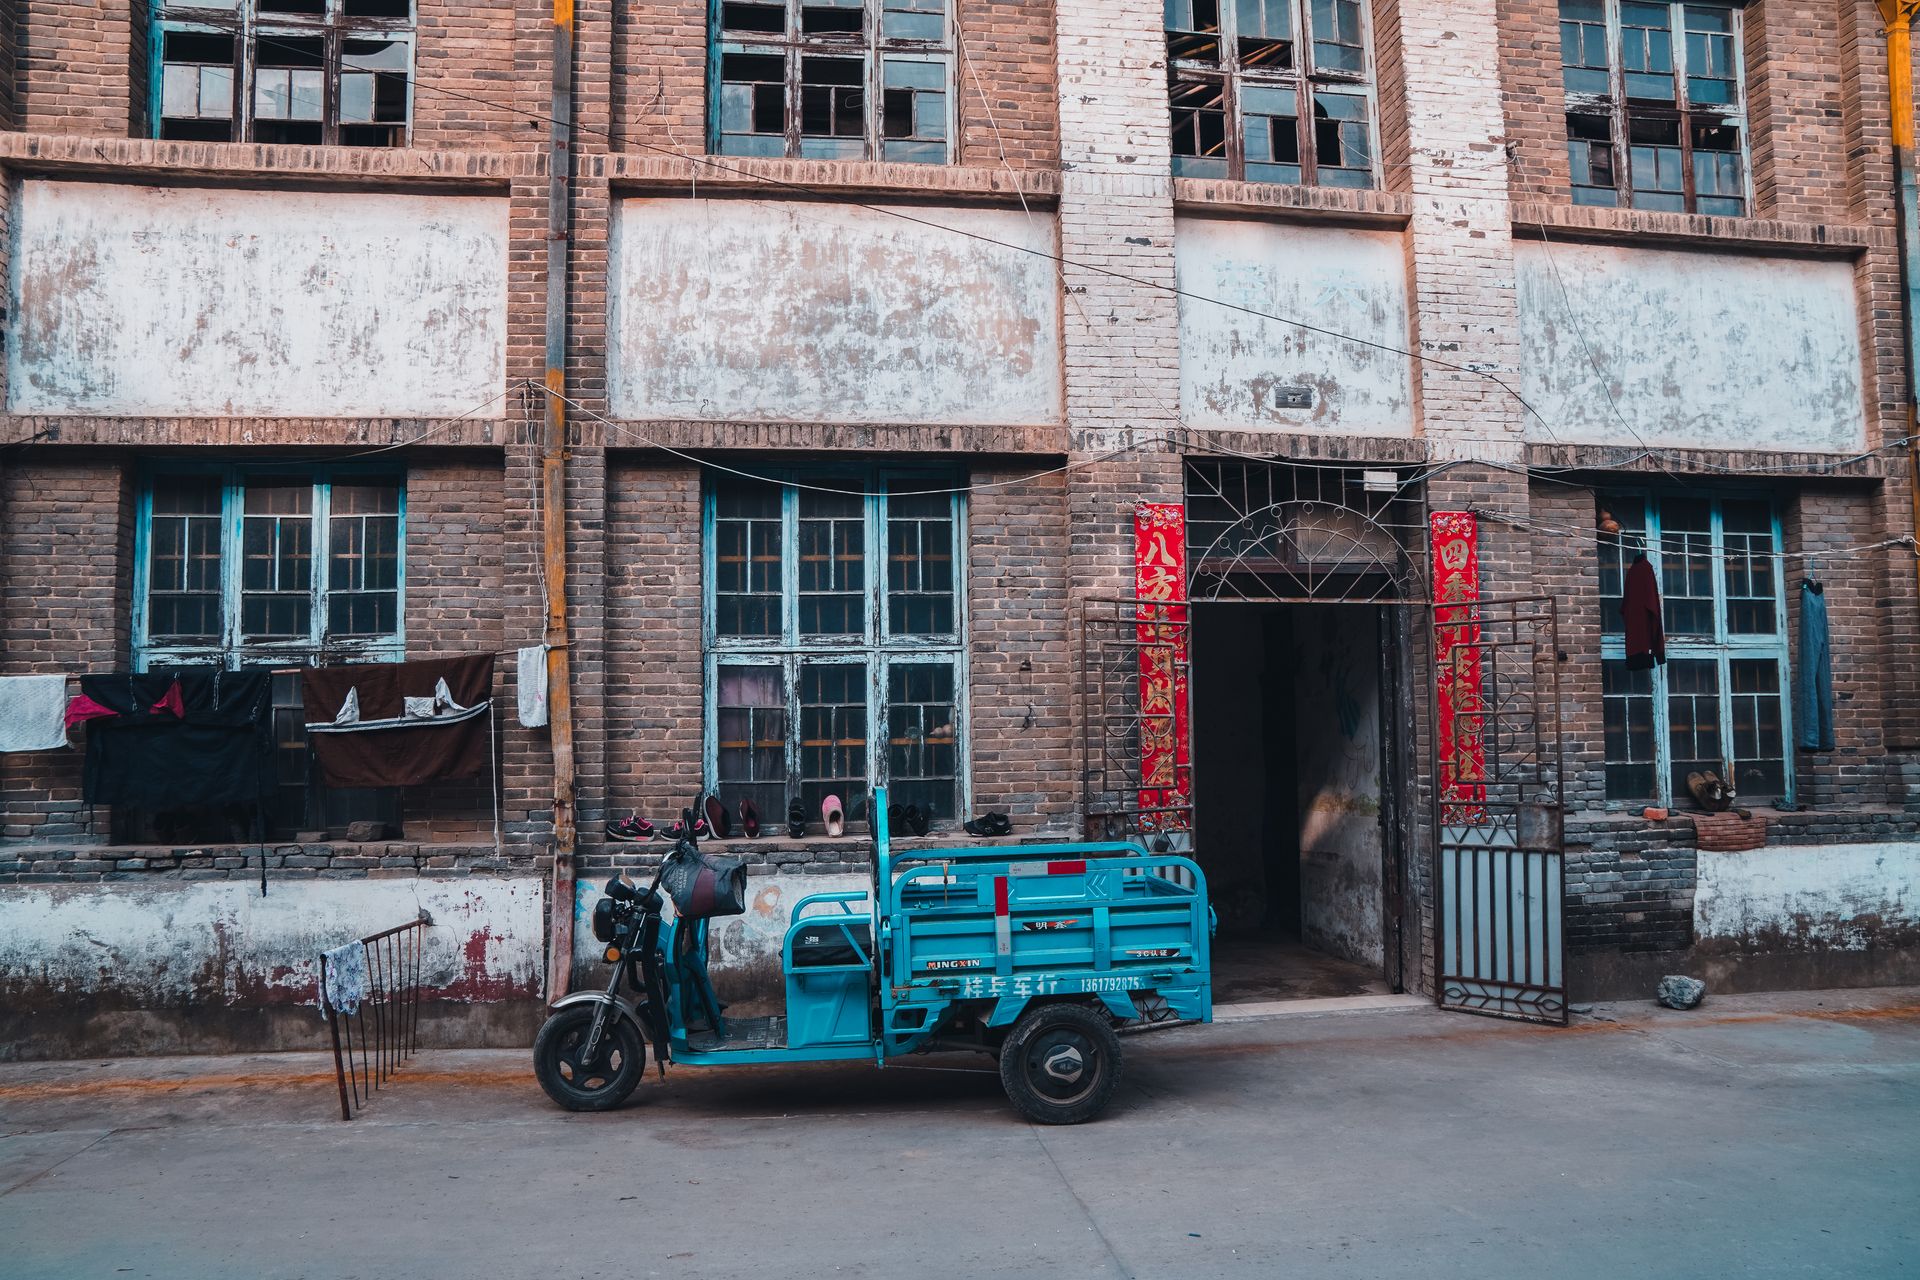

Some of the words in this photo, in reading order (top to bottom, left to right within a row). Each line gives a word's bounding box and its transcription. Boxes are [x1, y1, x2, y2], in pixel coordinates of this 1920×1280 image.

[1035, 920, 1067, 930] 明鑫
[1136, 949, 1168, 958] 3C认证
[927, 959, 980, 970] MINGXIN
